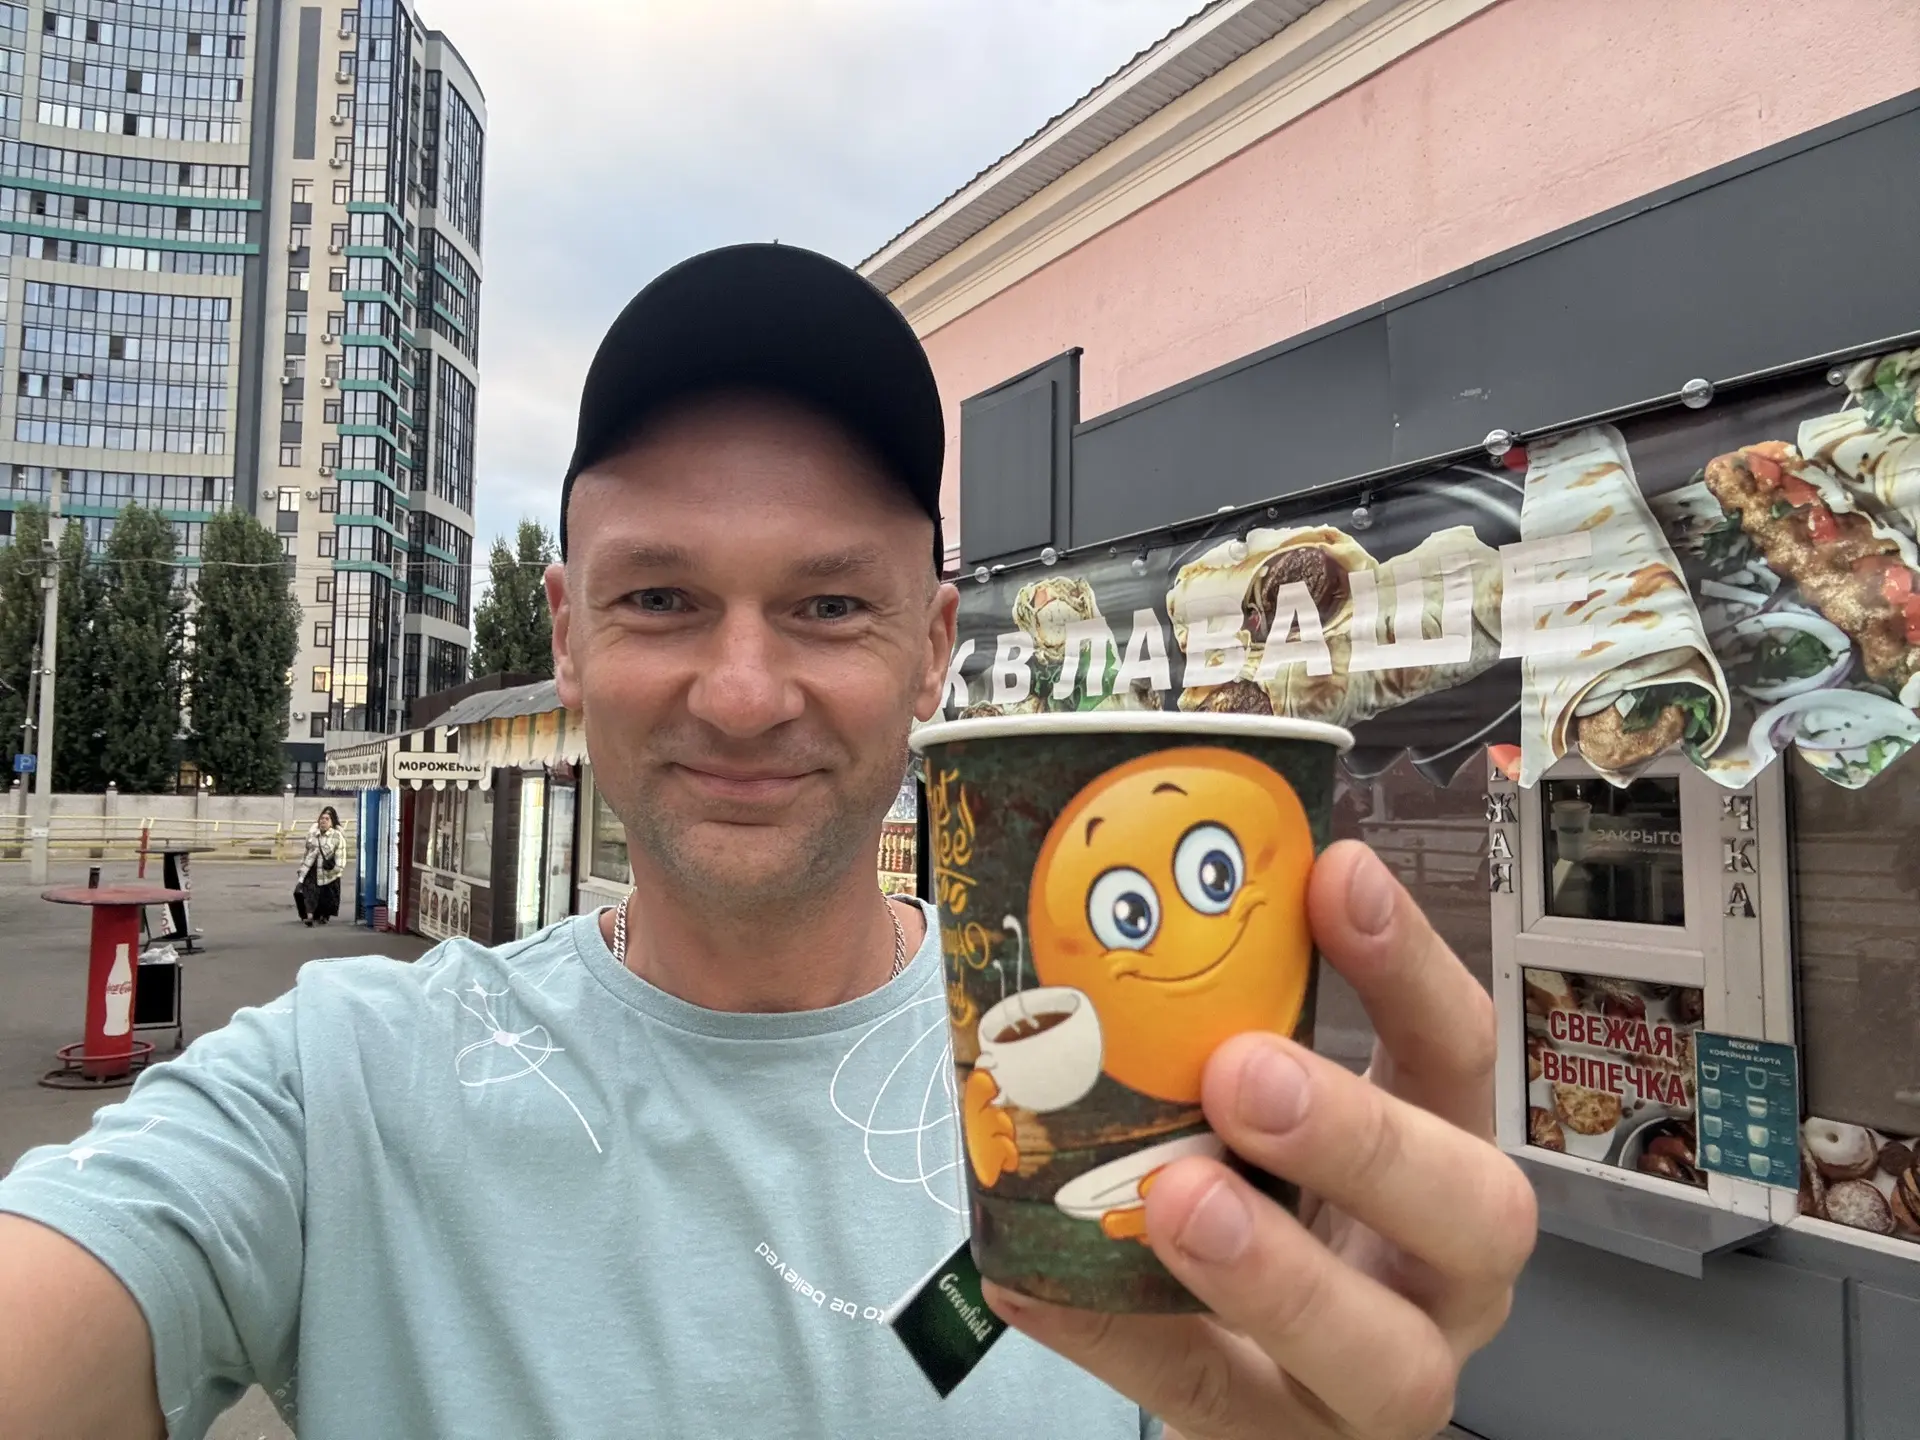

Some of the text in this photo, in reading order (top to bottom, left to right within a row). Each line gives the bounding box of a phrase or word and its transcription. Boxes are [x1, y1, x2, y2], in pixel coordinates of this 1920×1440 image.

[1596, 828, 1682, 846] ЗАКРЫТО
[1550, 1010, 1674, 1058] СВЕЖАЯ
[1543, 1051, 1688, 1108] ВЫПЕЧКА
[754, 1241, 886, 1325] to be believed
[937, 1272, 994, 1343] Greenfield
